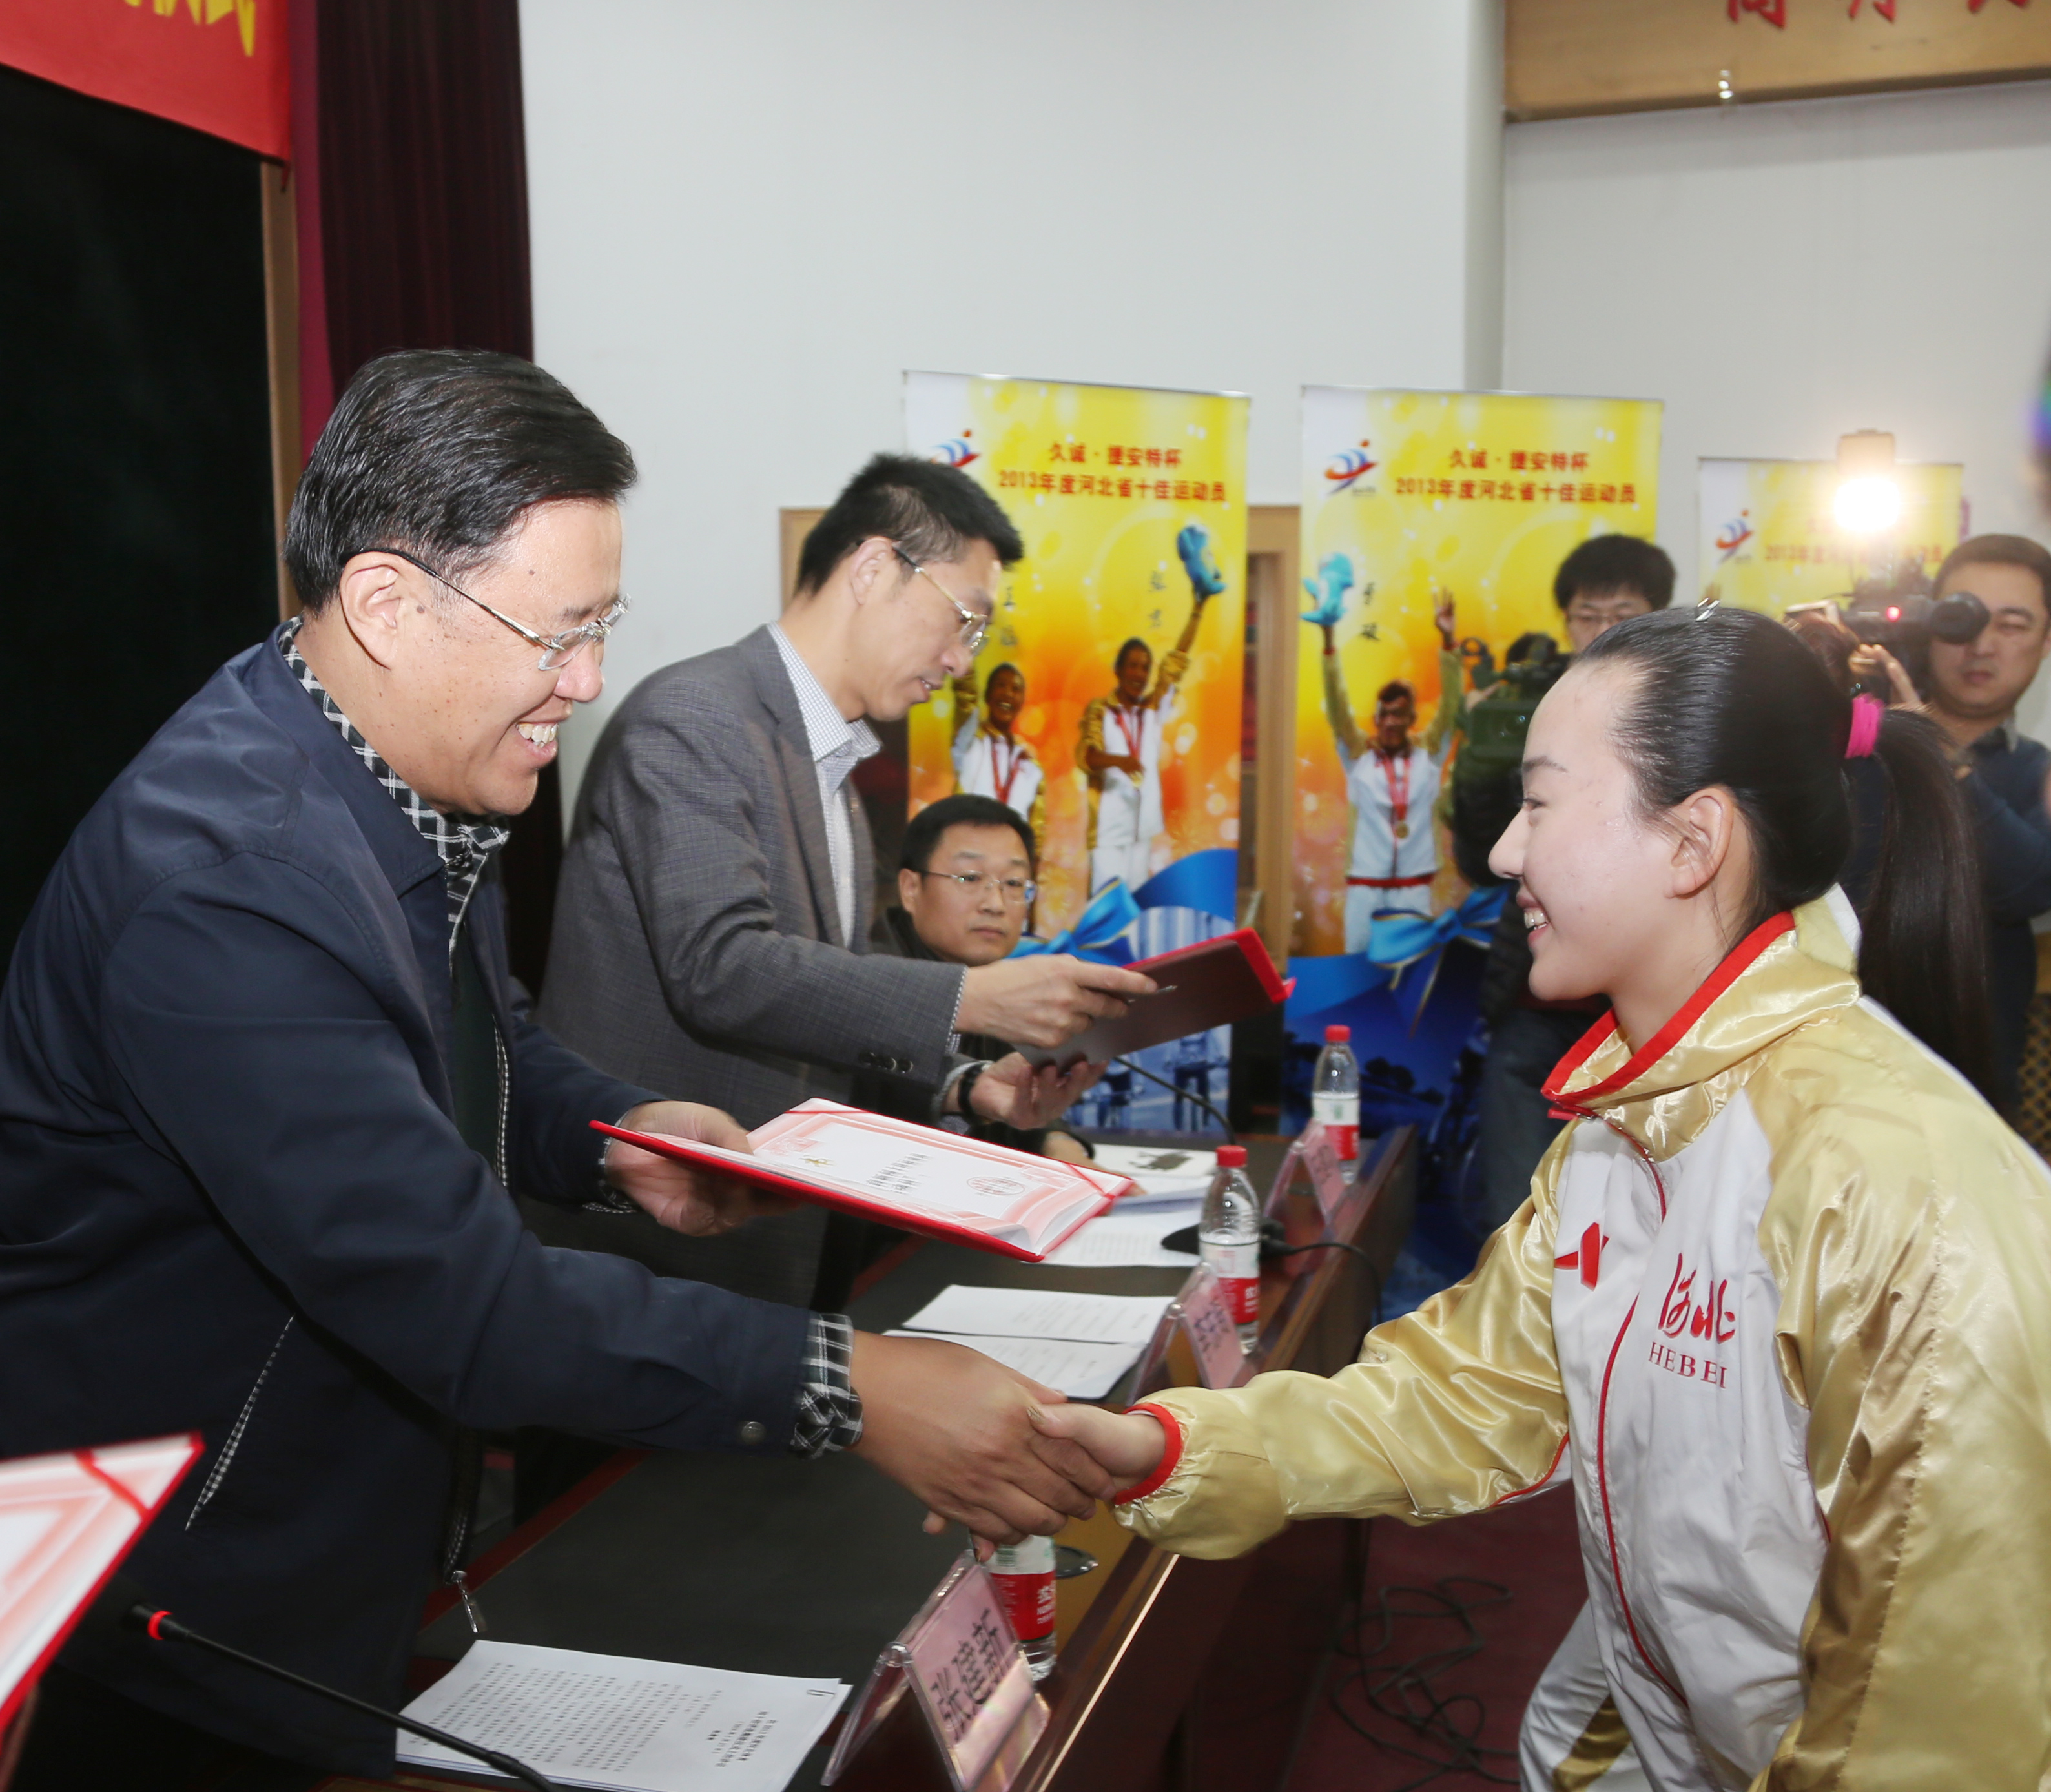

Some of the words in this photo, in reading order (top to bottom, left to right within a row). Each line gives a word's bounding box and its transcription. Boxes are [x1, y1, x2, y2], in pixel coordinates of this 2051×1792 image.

[999, 470, 1226, 502] 2013年度河北省十佳运动员
[1396, 477, 1635, 503] 2013年度河北省十佳运动员
[1648, 1341, 1728, 1389] HEBEI
